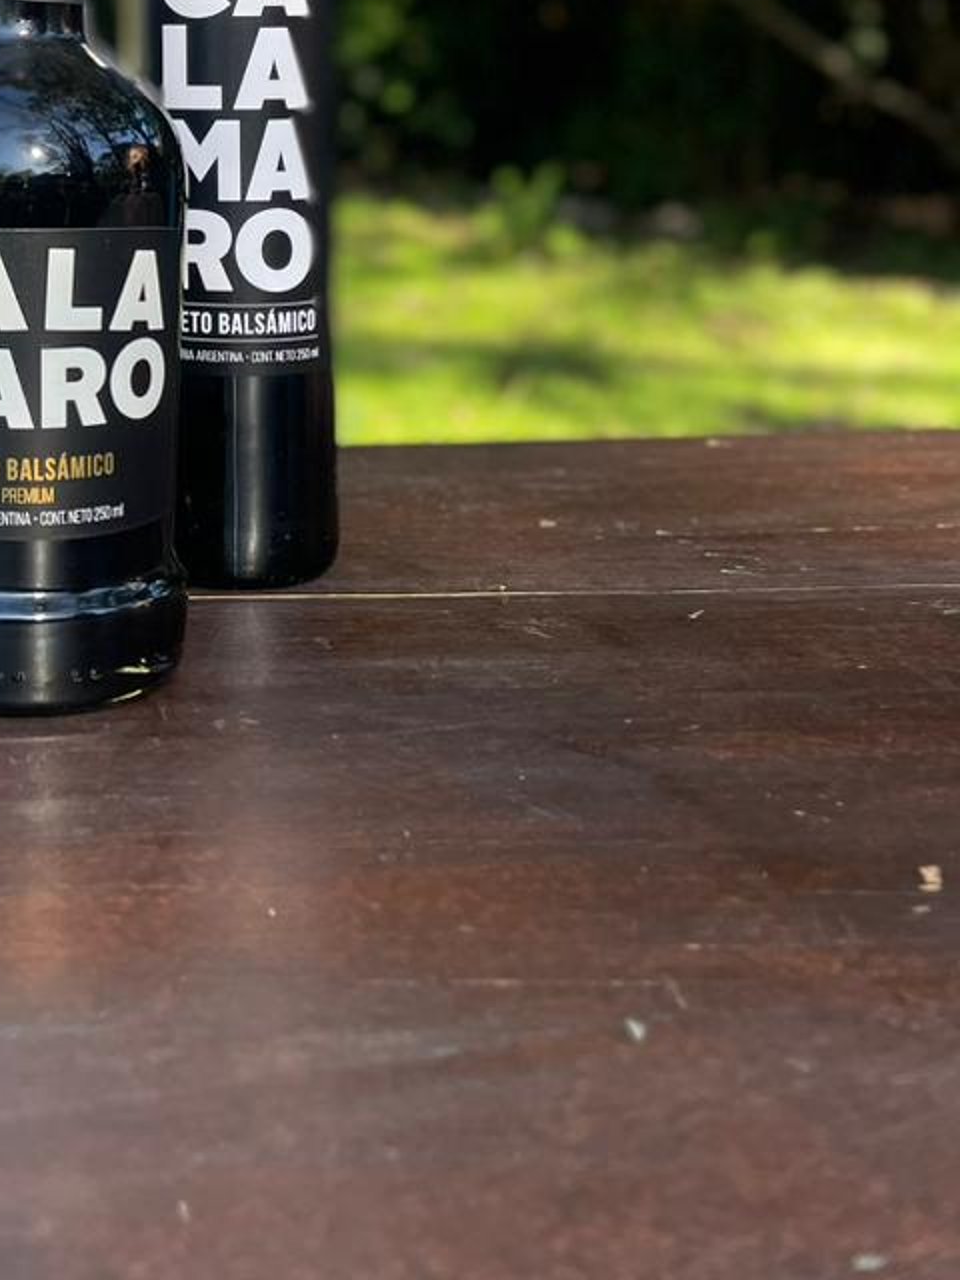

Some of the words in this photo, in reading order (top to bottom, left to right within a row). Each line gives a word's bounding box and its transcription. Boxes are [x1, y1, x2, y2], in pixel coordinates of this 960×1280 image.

[162, 24, 312, 111] LA
[177, 118, 312, 202] MA
[183, 207, 314, 293] RO
[181, 310, 212, 333] ETO
[218, 307, 316, 335] BALSÁMICO
[6, 451, 115, 481] BALSÁMICO
[1, 486, 55, 505] PREMIUM
[67, 508, 93, 524] NETO
